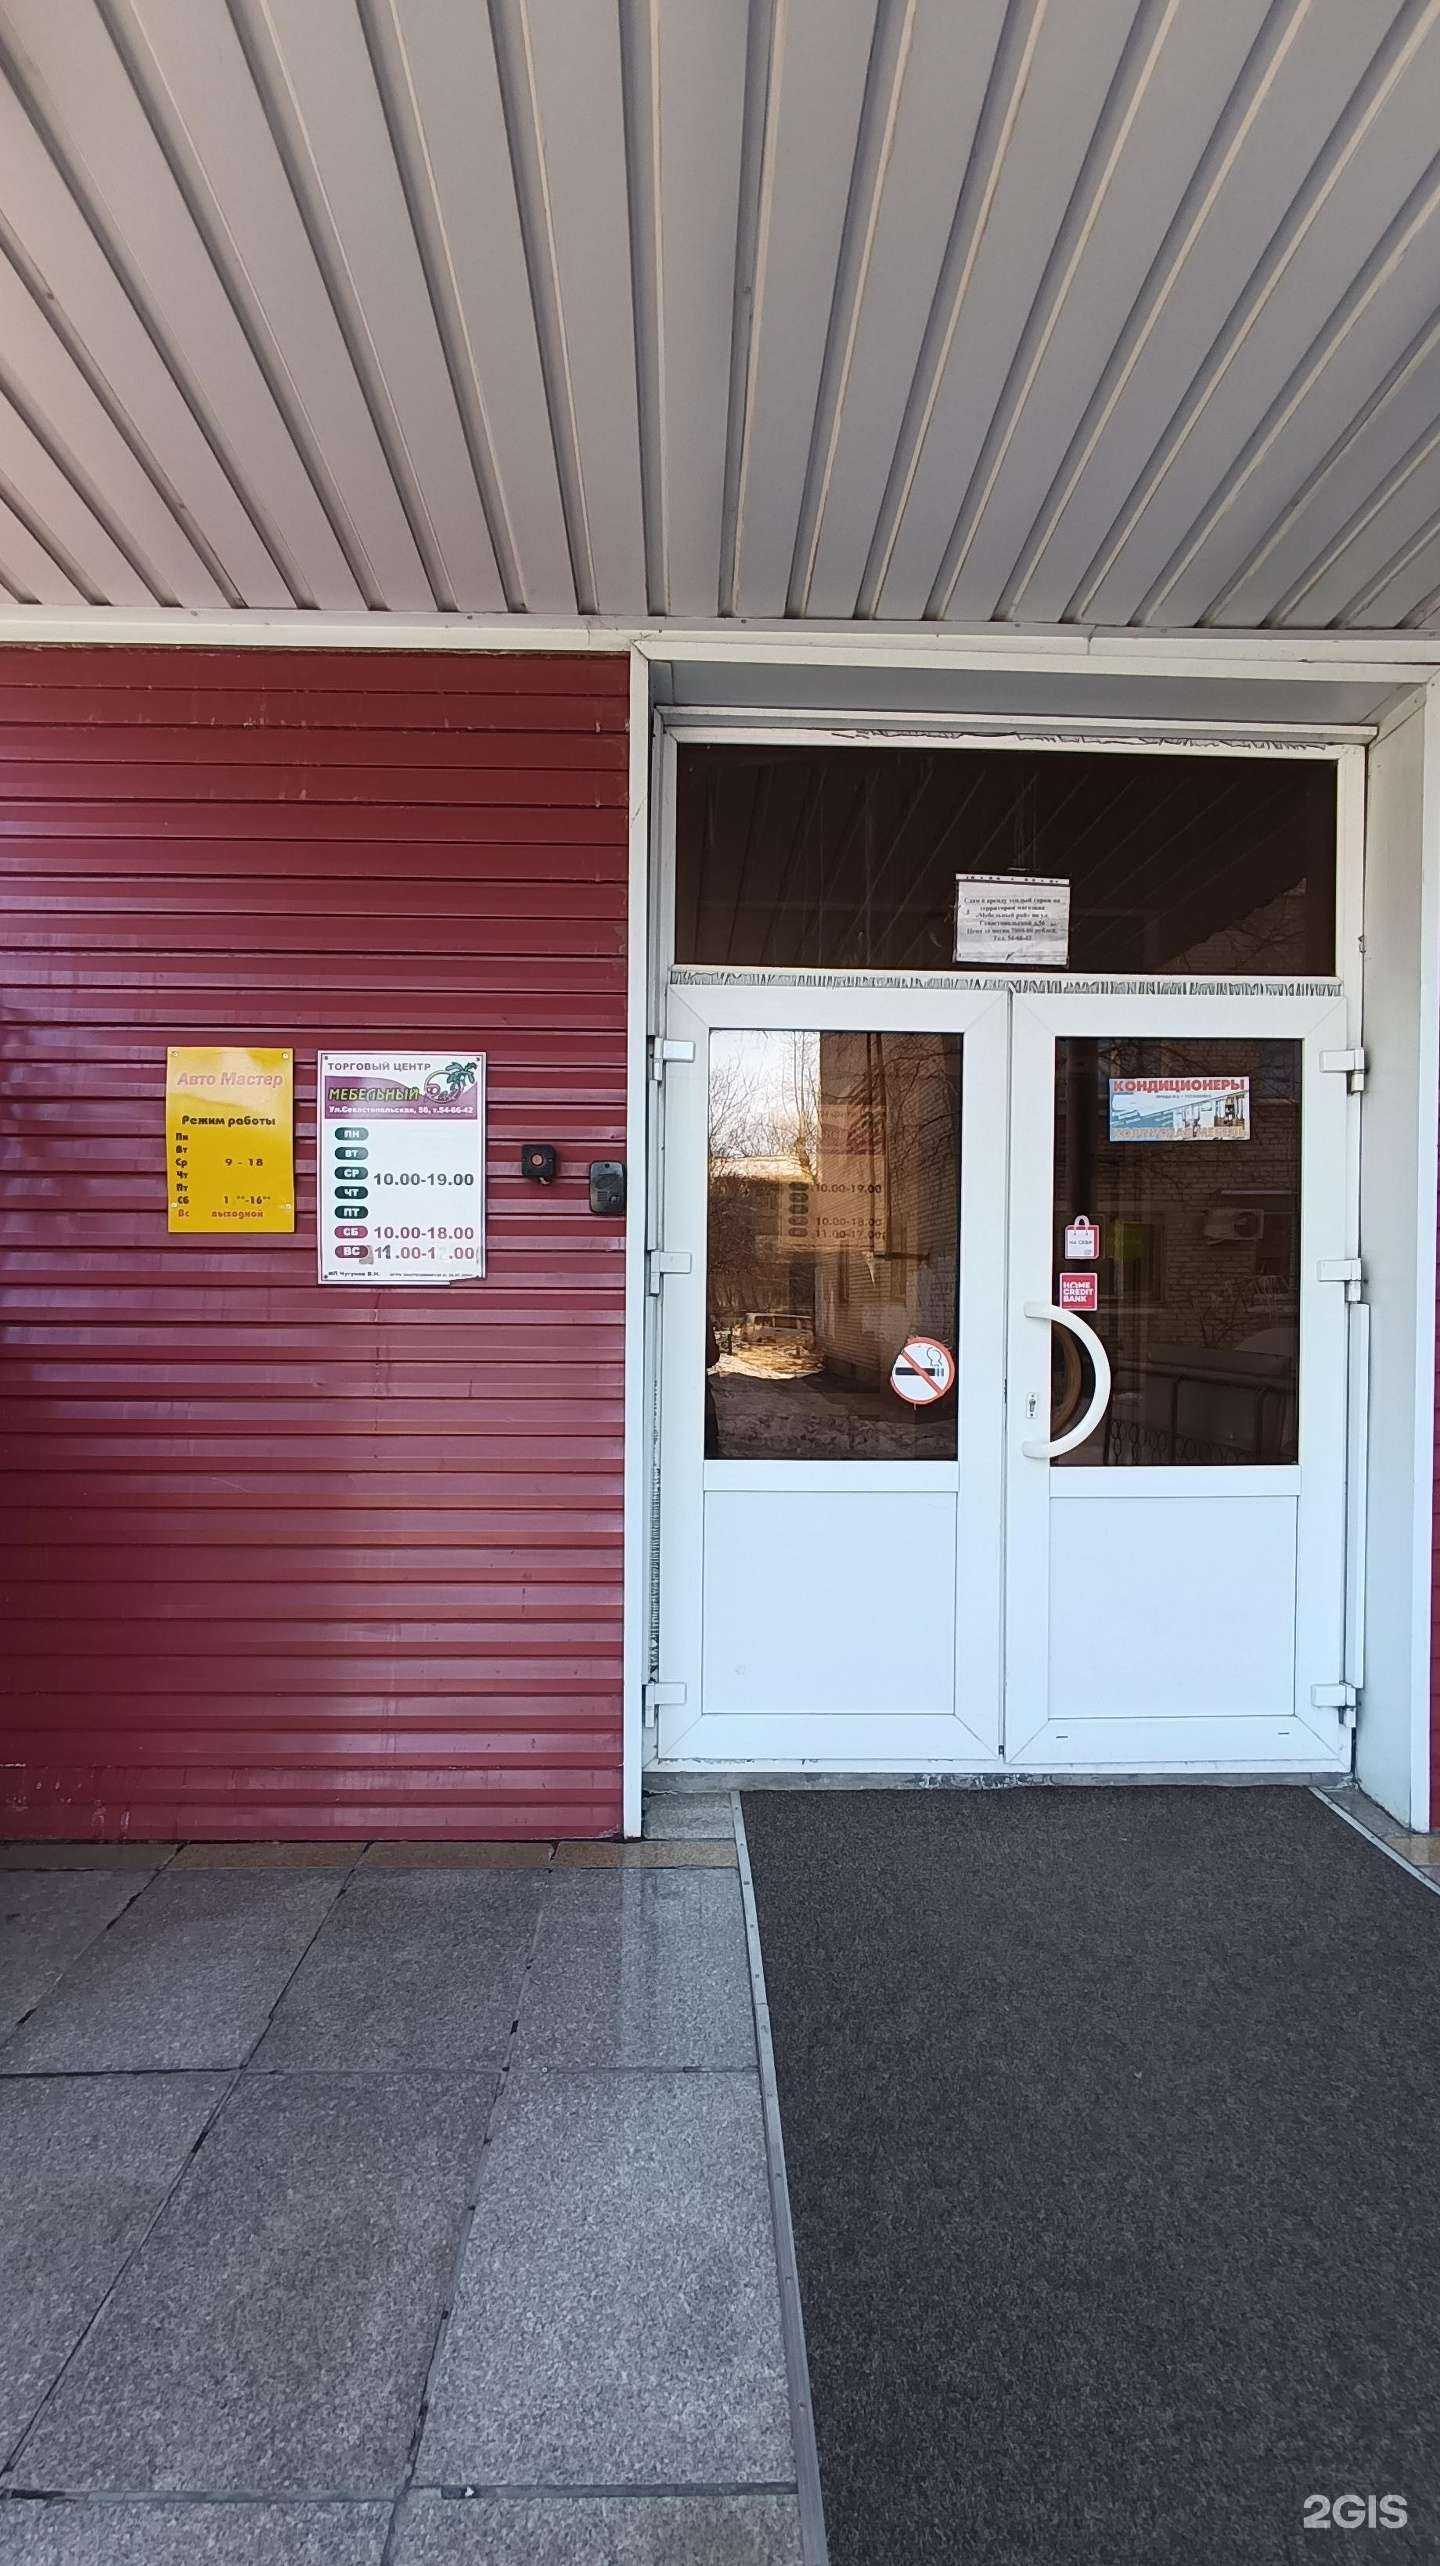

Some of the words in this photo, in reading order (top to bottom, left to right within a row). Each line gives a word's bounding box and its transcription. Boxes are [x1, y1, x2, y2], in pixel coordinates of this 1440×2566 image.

[327, 1061, 390, 1071] ТОРГОВЫЙ
[393, 1062, 431, 1072] ЦЕНТР
[177, 1072, 216, 1086] Авто
[220, 1072, 283, 1088] Мастер
[1113, 1079, 1245, 1092] КОНДИЦИОНЕРЫ
[328, 1086, 421, 1101] МЕБЕЛЬНЫЙ
[181, 1115, 226, 1126] Режим
[227, 1115, 276, 1127] работы
[175, 1132, 188, 1141] Пн
[343, 1129, 360, 1138] ПН
[344, 1149, 358, 1158] ВТ
[175, 1158, 188, 1168] Ср
[225, 1158, 232, 1167] 9
[248, 1158, 263, 1167] 18
[343, 1168, 360, 1178] СР
[373, 1173, 474, 1186] 10.00-19.00
[343, 1188, 359, 1197] ЧТ
[815, 1183, 882, 1194] 10.00-19.00
[178, 1209, 190, 1218] Вс
[211, 1209, 264, 1219] выходной
[343, 1208, 359, 1217] ПТ
[816, 1217, 882, 1227] 10.00-18.00
[343, 1227, 359, 1237] СБ
[374, 1226, 474, 1240] 10.00-18.00
[343, 1247, 360, 1257] ВС
[1063, 1281, 1091, 1289] HOME
[1063, 1288, 1094, 1296] CREDIT
[1063, 1295, 1087, 1303] BANK
